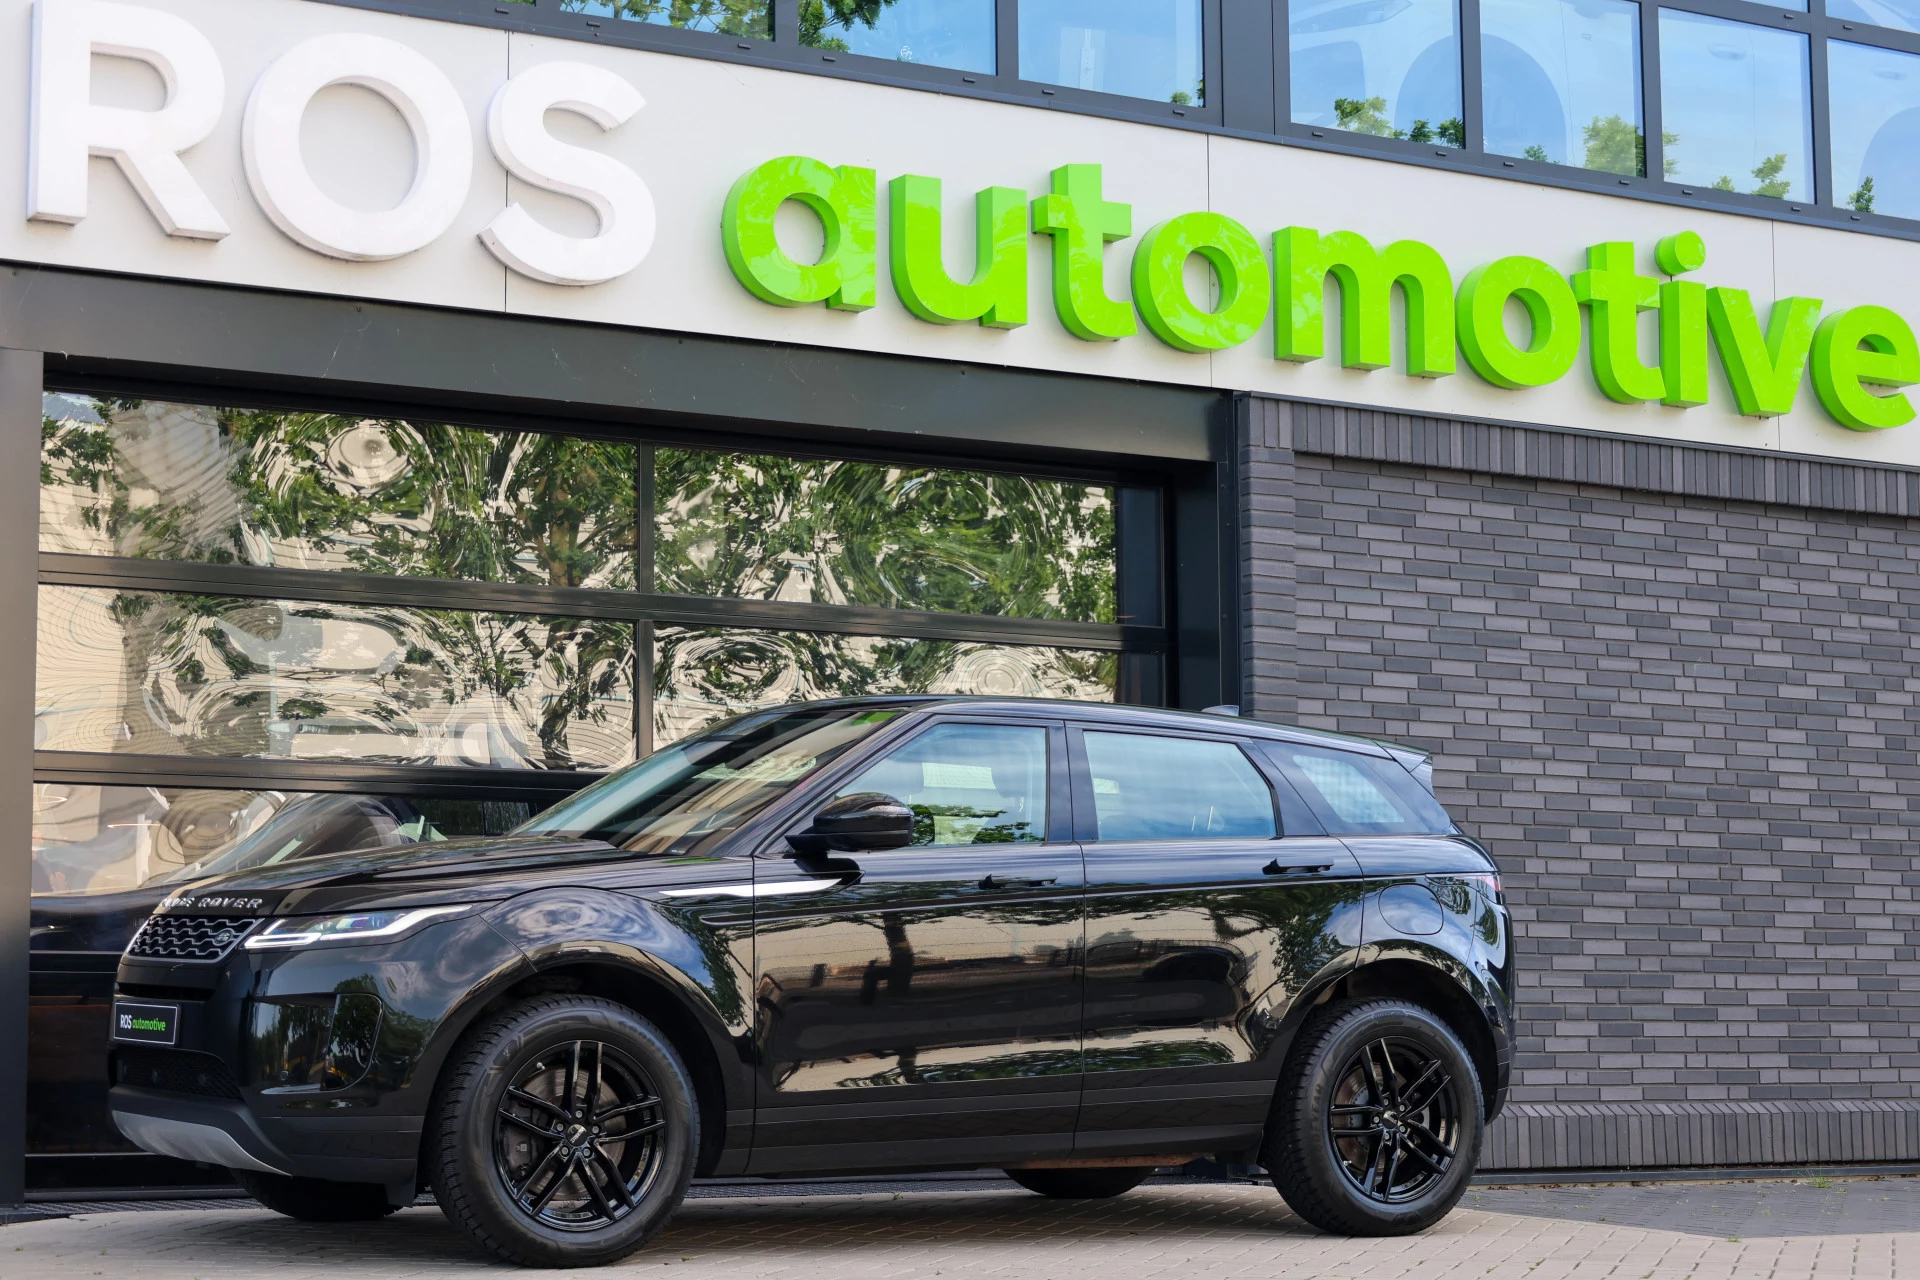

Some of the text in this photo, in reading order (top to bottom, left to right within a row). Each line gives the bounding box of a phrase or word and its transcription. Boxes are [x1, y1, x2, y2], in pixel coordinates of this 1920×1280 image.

[27, 0, 1920, 432] ROS automotive
[198, 898, 263, 908] ROVER
[120, 1014, 167, 1032] ROS automotive
